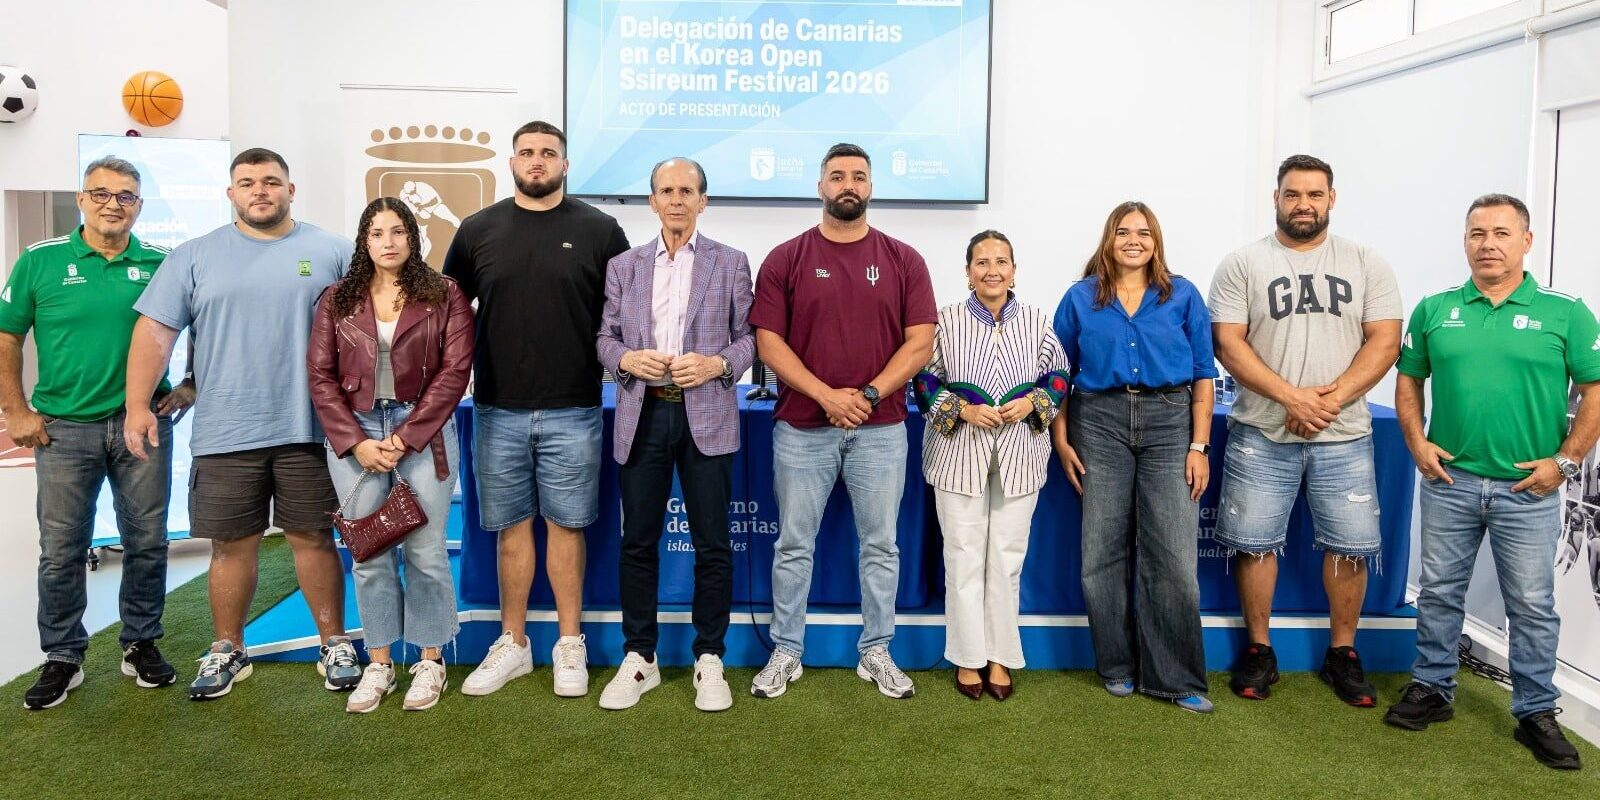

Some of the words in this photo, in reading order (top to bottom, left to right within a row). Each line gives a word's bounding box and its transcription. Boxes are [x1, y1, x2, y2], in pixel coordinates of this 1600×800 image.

[620, 16, 753, 43] Delegación
[760, 18, 789, 40] de
[796, 18, 902, 42] Canarias
[620, 46, 648, 64] en
[656, 43, 677, 64] el
[683, 43, 753, 65] Korea
[761, 44, 822, 72] Open
[620, 68, 717, 91] Ssireum
[725, 69, 818, 93] Festival
[825, 71, 889, 94] 2026
[619, 103, 655, 115] ACTO
[659, 103, 676, 115] DE
[679, 101, 781, 117] PRESENTACIÓN
[1267, 273, 1353, 321] GAP
[666, 516, 690, 533] de
